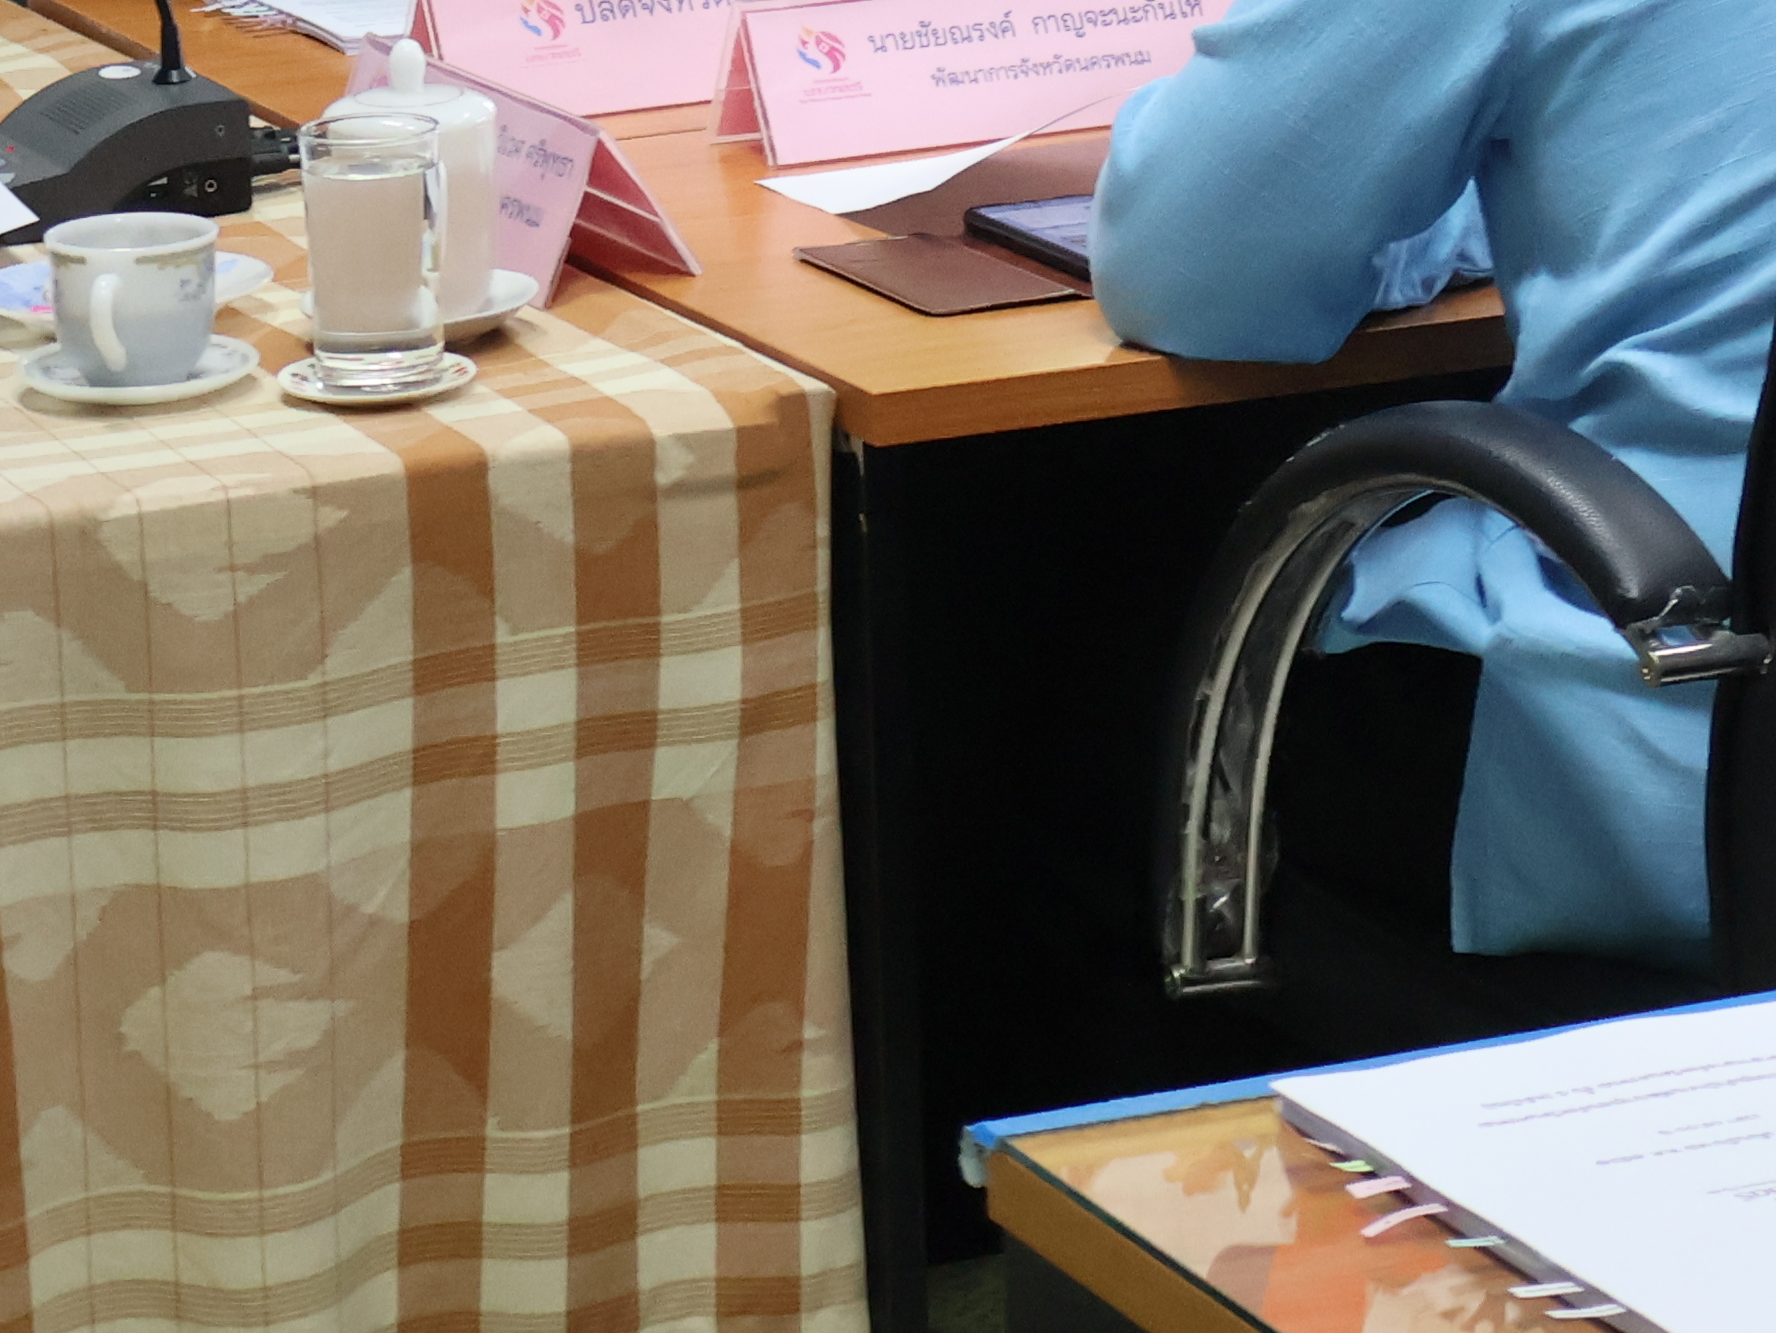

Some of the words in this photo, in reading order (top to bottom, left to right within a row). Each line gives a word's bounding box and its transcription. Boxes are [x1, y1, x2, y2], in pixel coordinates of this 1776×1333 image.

[867, 11, 1015, 54] นายชัยณรงค์
[930, 48, 1152, 88] พัฒนาการจังหวัดนครพนม
